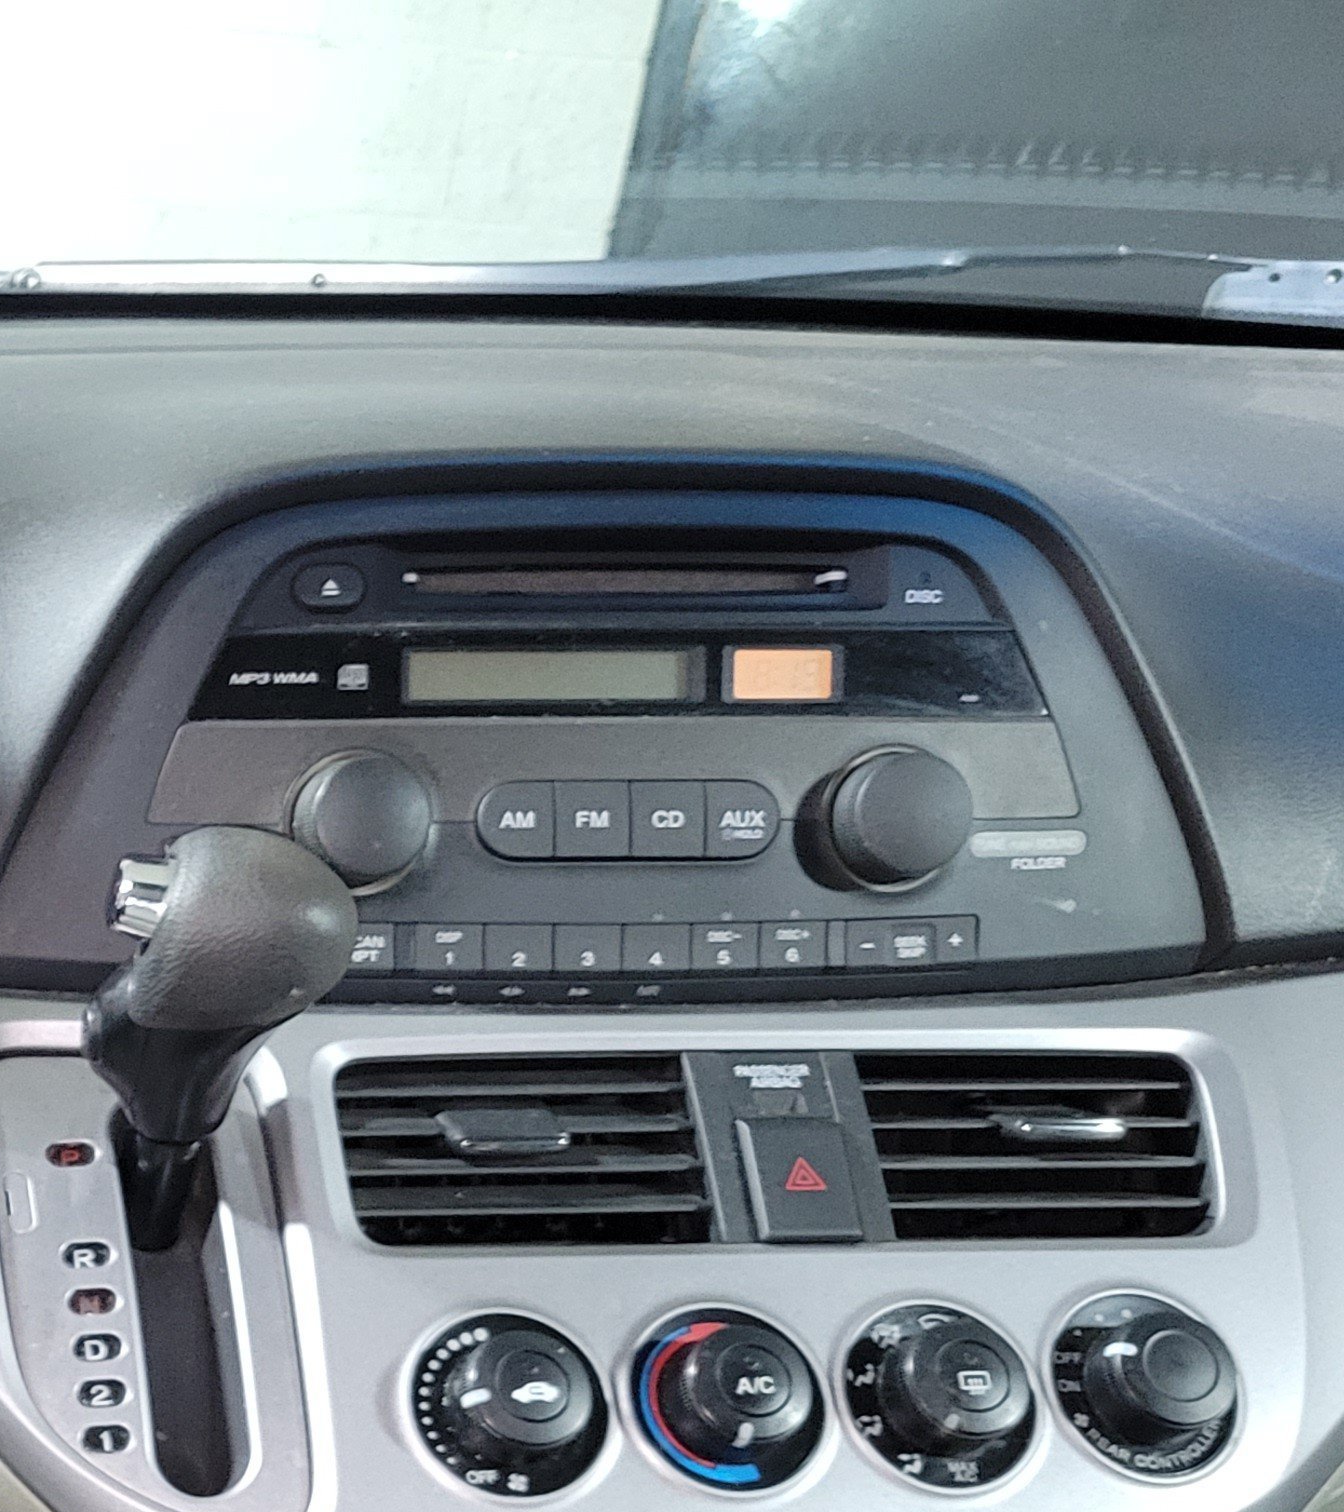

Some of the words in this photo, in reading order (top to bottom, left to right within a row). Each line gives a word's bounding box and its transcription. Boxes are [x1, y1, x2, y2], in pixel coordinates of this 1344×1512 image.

[229, 672, 270, 687] MP3
[272, 671, 320, 686] WMA
[498, 810, 536, 829] AM
[575, 810, 610, 829] FM
[650, 809, 685, 829] CD
[718, 809, 766, 828] AUX
[444, 950, 455, 966] 1
[511, 951, 527, 967] 2
[580, 951, 596, 967] 3
[647, 951, 664, 967] 4
[716, 950, 732, 966] 5
[784, 946, 801, 964] 6
[61, 1149, 80, 1163] P
[73, 1249, 96, 1268] R
[79, 1295, 102, 1314] N
[84, 1339, 110, 1362] D
[90, 1384, 114, 1406] 2
[735, 1376, 776, 1397] A/C
[98, 1430, 112, 1452] 1
[465, 1469, 500, 1485] OFF
